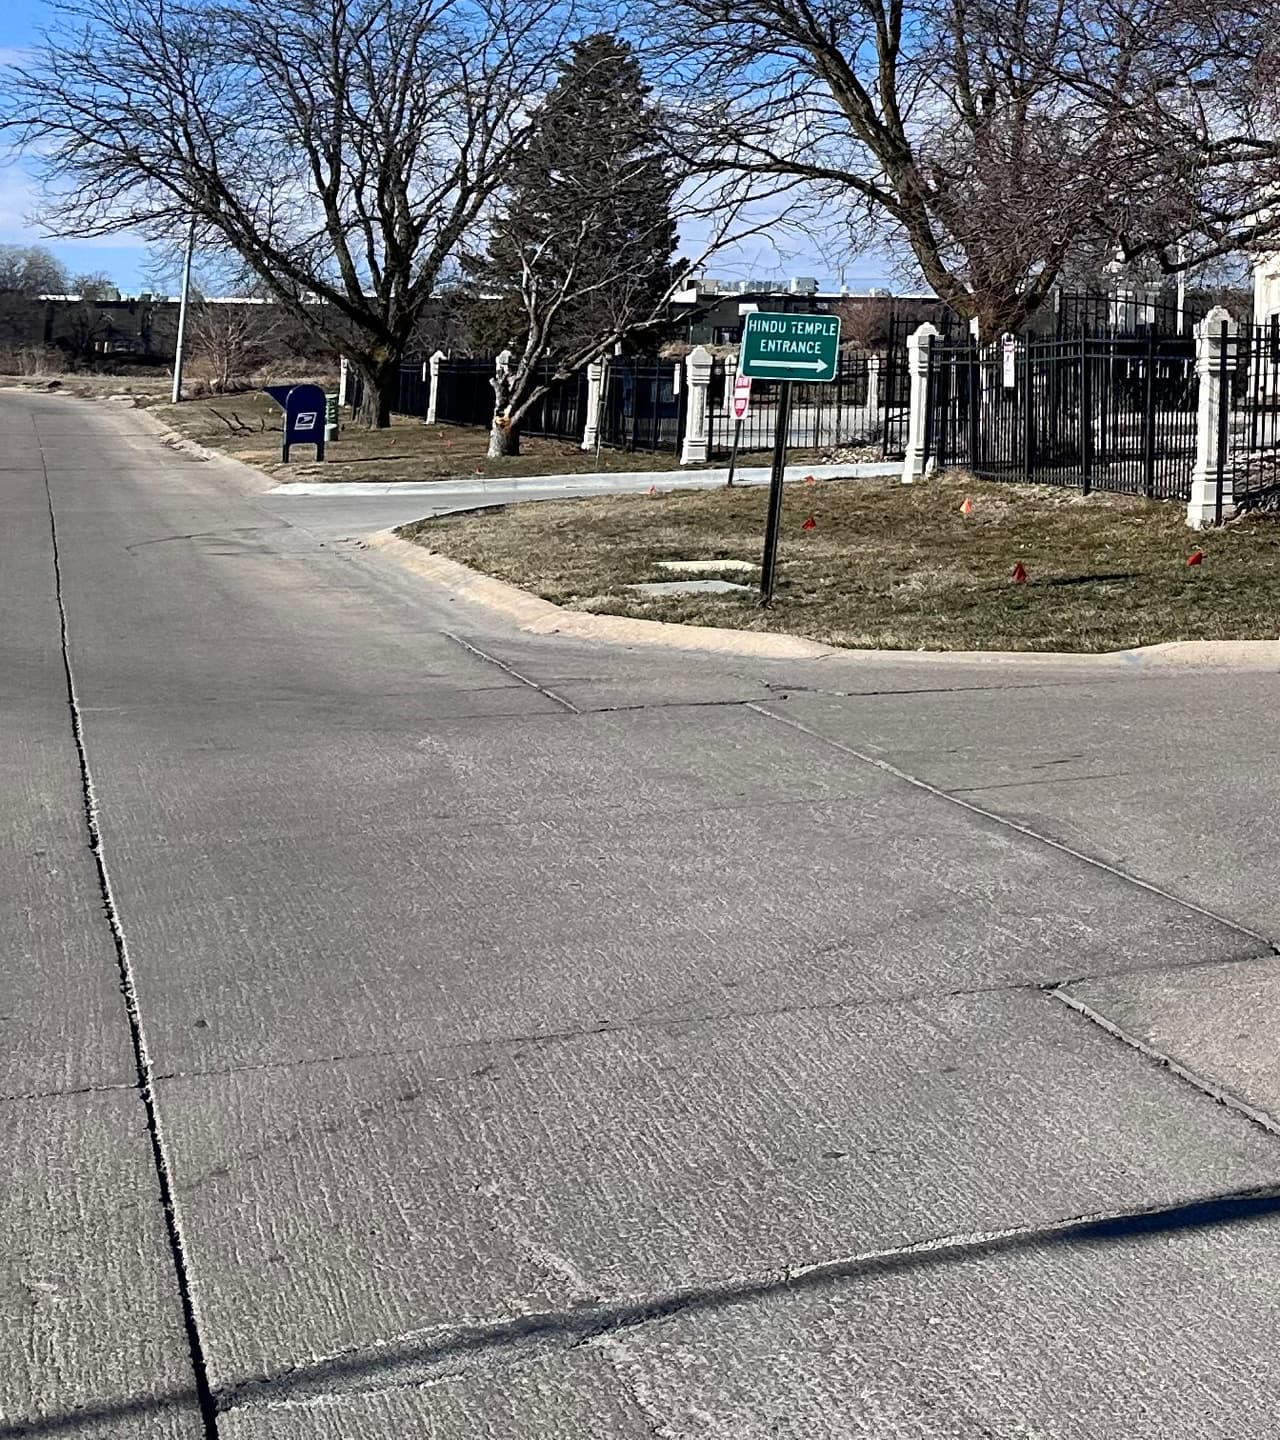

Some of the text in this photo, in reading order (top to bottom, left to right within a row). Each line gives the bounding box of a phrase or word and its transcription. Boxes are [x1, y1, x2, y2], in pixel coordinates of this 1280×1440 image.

[748, 320, 837, 336] HINDU TEMPLE
[760, 339, 822, 354] ENTRANCE
